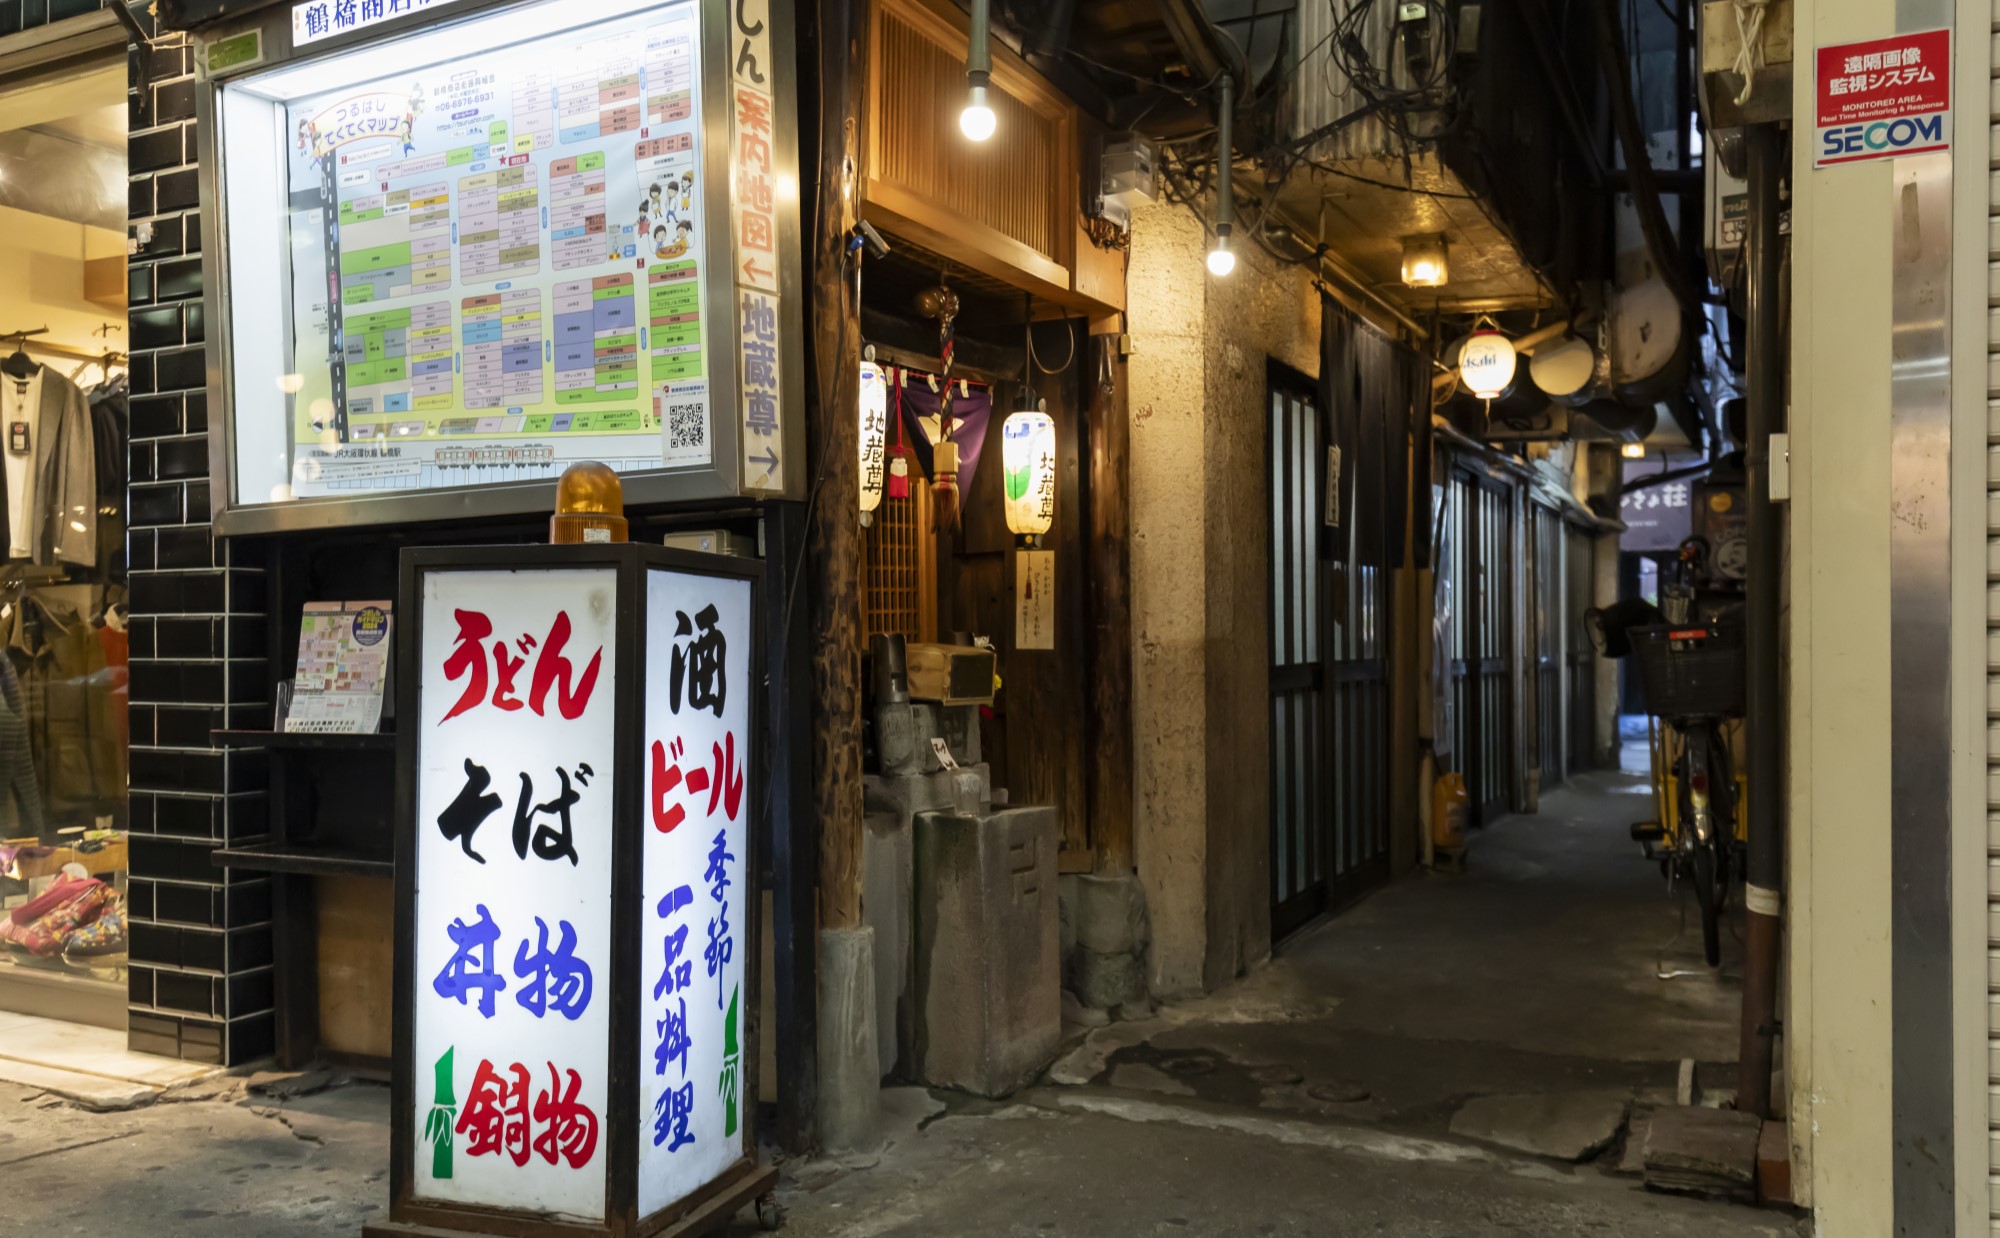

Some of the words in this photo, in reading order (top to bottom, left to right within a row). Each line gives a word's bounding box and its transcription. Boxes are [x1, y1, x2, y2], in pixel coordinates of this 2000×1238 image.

[305, 0, 442, 38] 鶴橋商店
[1844, 47, 1921, 74] 遠隔画像
[336, 98, 386, 122] つるはし
[1821, 115, 1837, 123] Real
[1839, 112, 1856, 121] Time
[1858, 108, 1898, 118] Monitoring
[1907, 101, 1944, 112] Response
[1829, 66, 1936, 96] 監視システム
[1842, 98, 1895, 112] MONITORED
[1897, 95, 1922, 105] AREA
[324, 116, 401, 145] てくてくマップ
[738, 87, 774, 254] 案内地図
[1823, 115, 1942, 156] SECOM
[742, 293, 779, 436] 地蔵尊
[334, 448, 378, 458] JR大阪環状線
[862, 408, 885, 496] 地蔵尊
[1037, 451, 1055, 522] 地蔵尊
[437, 607, 603, 727] うどん
[669, 603, 726, 719] 酒
[436, 757, 594, 867] そば
[651, 730, 743, 834] ビール
[432, 903, 593, 1020] 丼物
[703, 828, 735, 1010] 季節
[653, 884, 696, 1153] 一品料理
[455, 1058, 598, 1169] 鍋物
